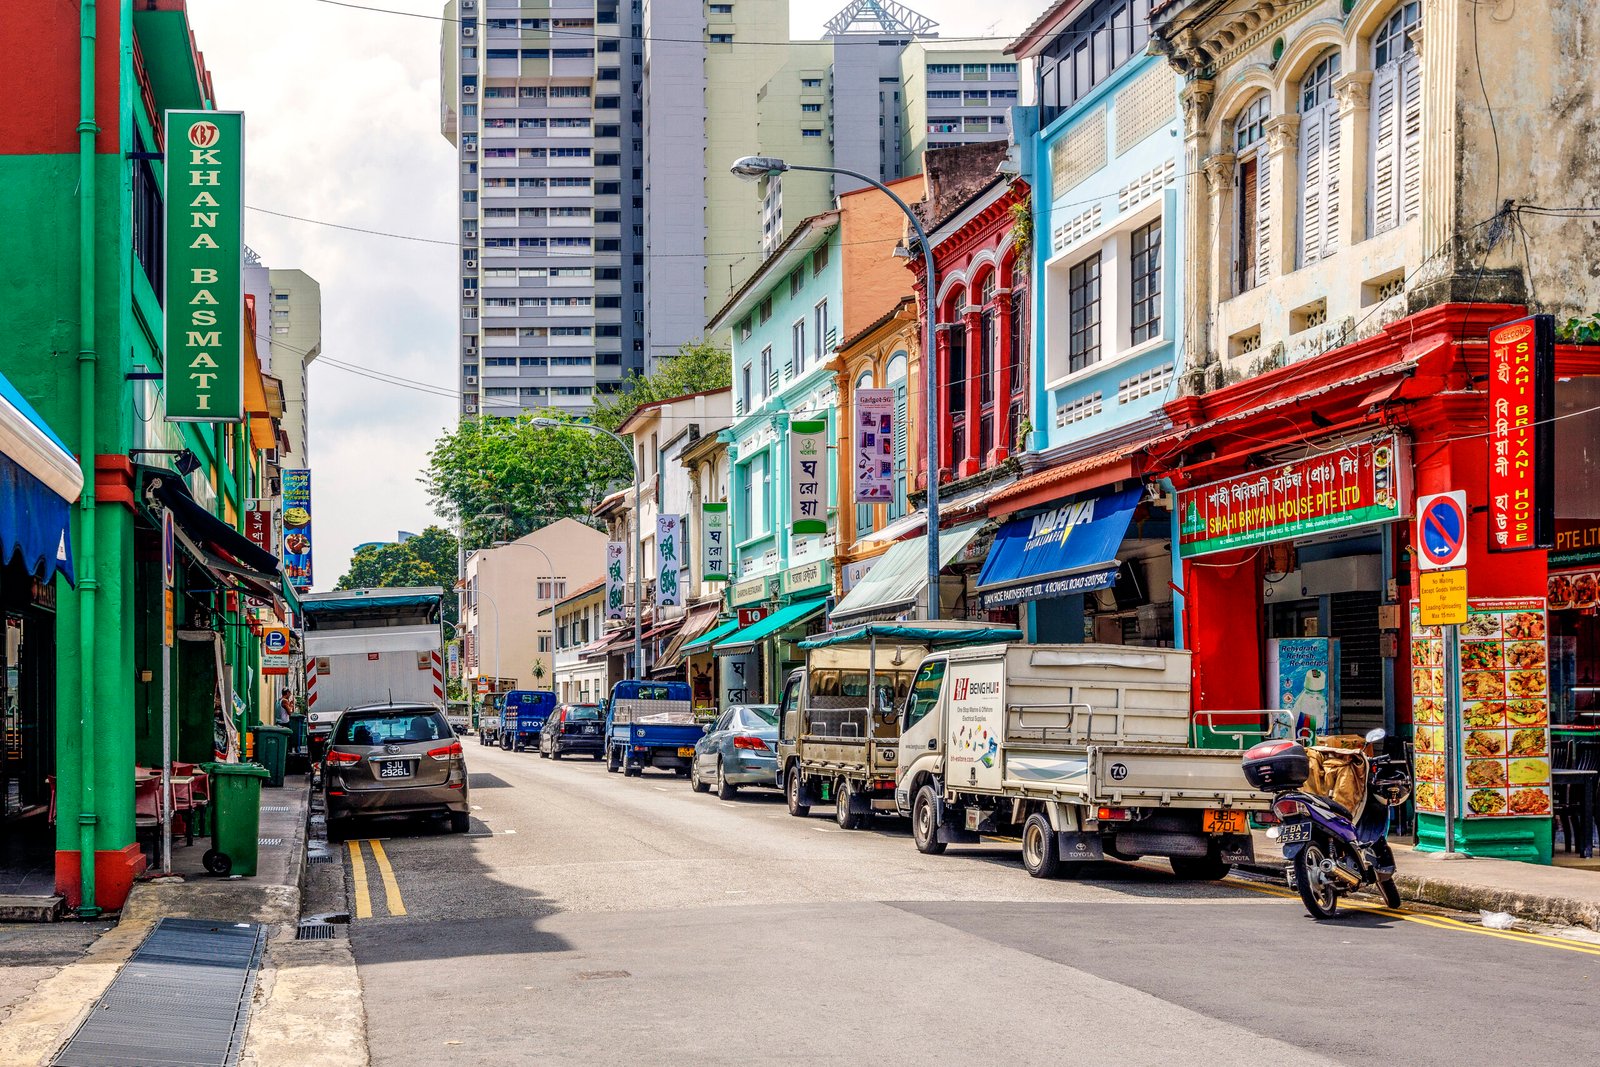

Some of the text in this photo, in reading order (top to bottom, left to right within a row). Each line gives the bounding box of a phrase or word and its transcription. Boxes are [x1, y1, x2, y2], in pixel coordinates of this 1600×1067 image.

[190, 126, 218, 146] KBT
[186, 150, 222, 410] KHANA BASMATI
[1514, 342, 1530, 542] SHAHI BRIYANI HOUSE
[1209, 512, 1237, 534] SHAHI
[1239, 504, 1277, 527] BRIYANI
[1278, 496, 1315, 520] HOUSE
[1316, 490, 1338, 512] PTE
[1339, 485, 1361, 507] LTD
[1028, 499, 1096, 540] NARVA
[1556, 525, 1600, 550] PTE LT
[1069, 577, 1084, 590] ROAD
[386, 761, 404, 769] SJU
[1112, 766, 1126, 776] 70
[381, 768, 410, 777] 2926L
[1213, 810, 1237, 821] GBC
[1208, 821, 1240, 832] 470L
[1284, 825, 1302, 834] FBA
